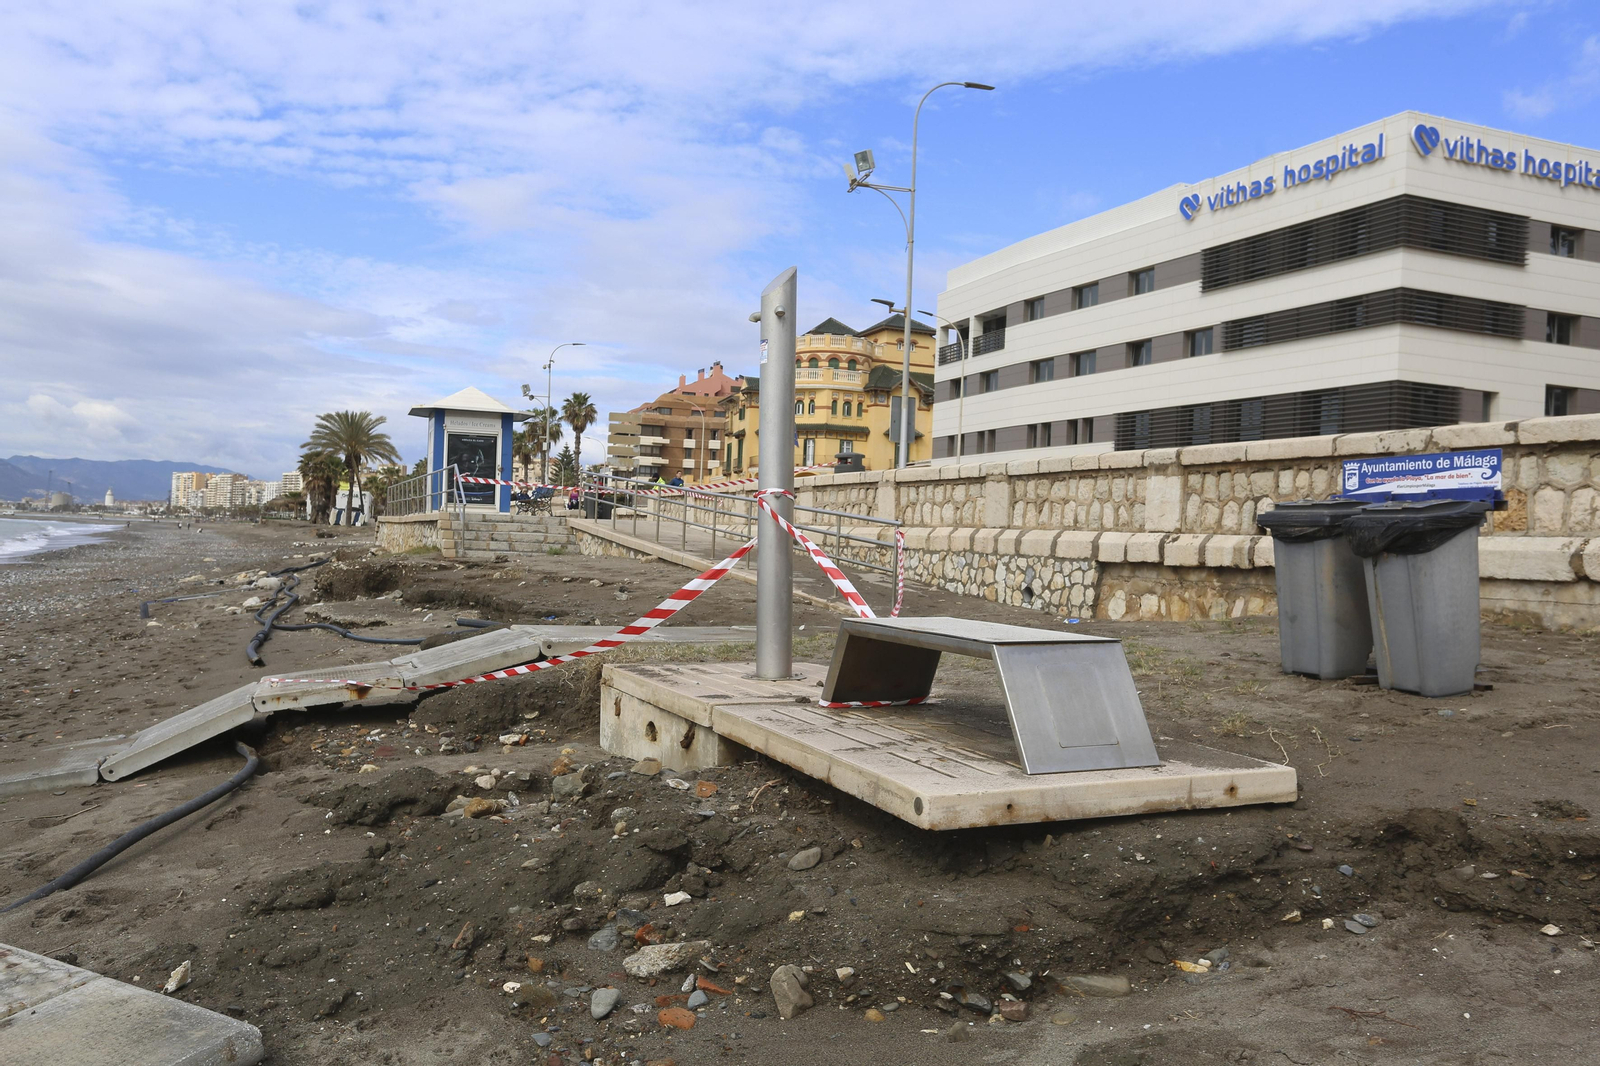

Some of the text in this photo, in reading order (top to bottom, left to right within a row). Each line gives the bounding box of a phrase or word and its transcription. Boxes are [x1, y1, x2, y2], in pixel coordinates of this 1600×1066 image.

[1443, 135, 1517, 171] vithas
[1206, 132, 1385, 211] vithas hospital
[1361, 455, 1498, 475] Ayuntamiento de Málaga
